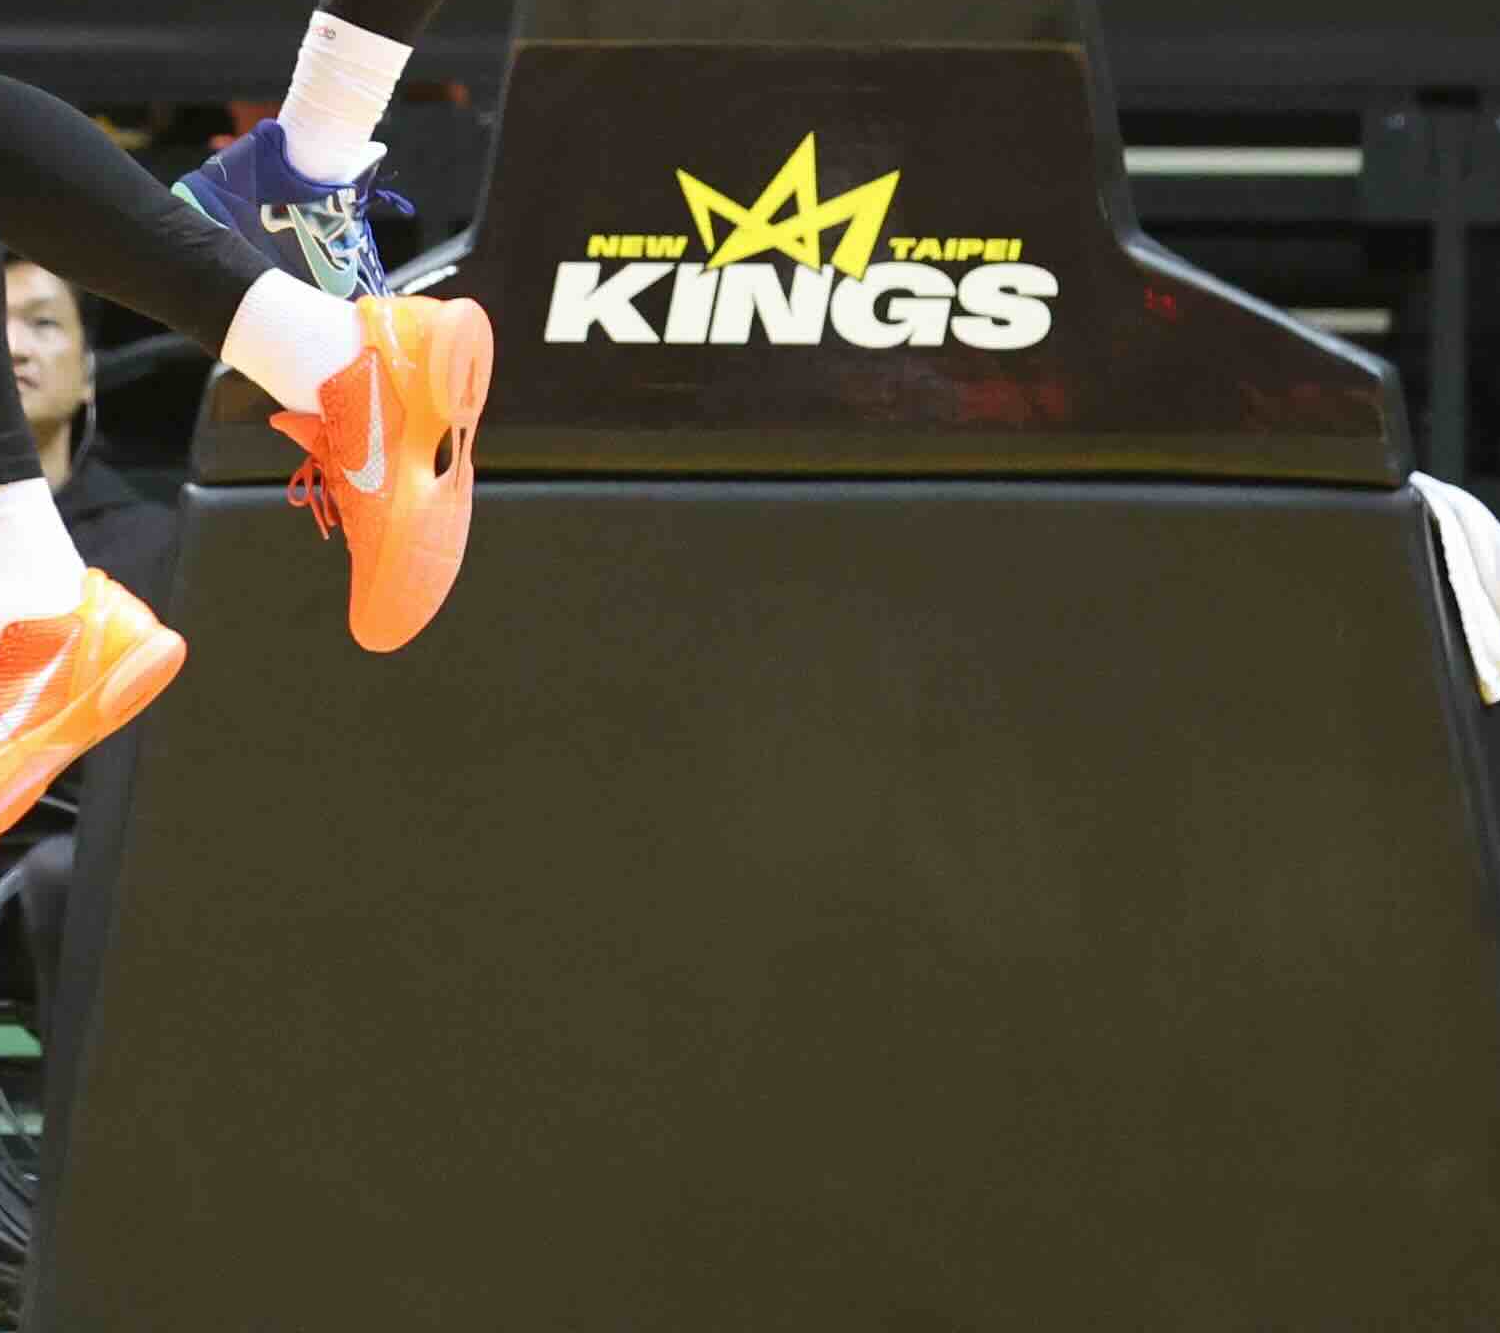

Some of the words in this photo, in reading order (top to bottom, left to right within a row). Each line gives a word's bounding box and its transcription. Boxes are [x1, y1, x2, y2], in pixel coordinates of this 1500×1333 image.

[587, 233, 689, 260] NEW
[888, 236, 1024, 262] TAIPEI
[543, 261, 1060, 350] KINGS
